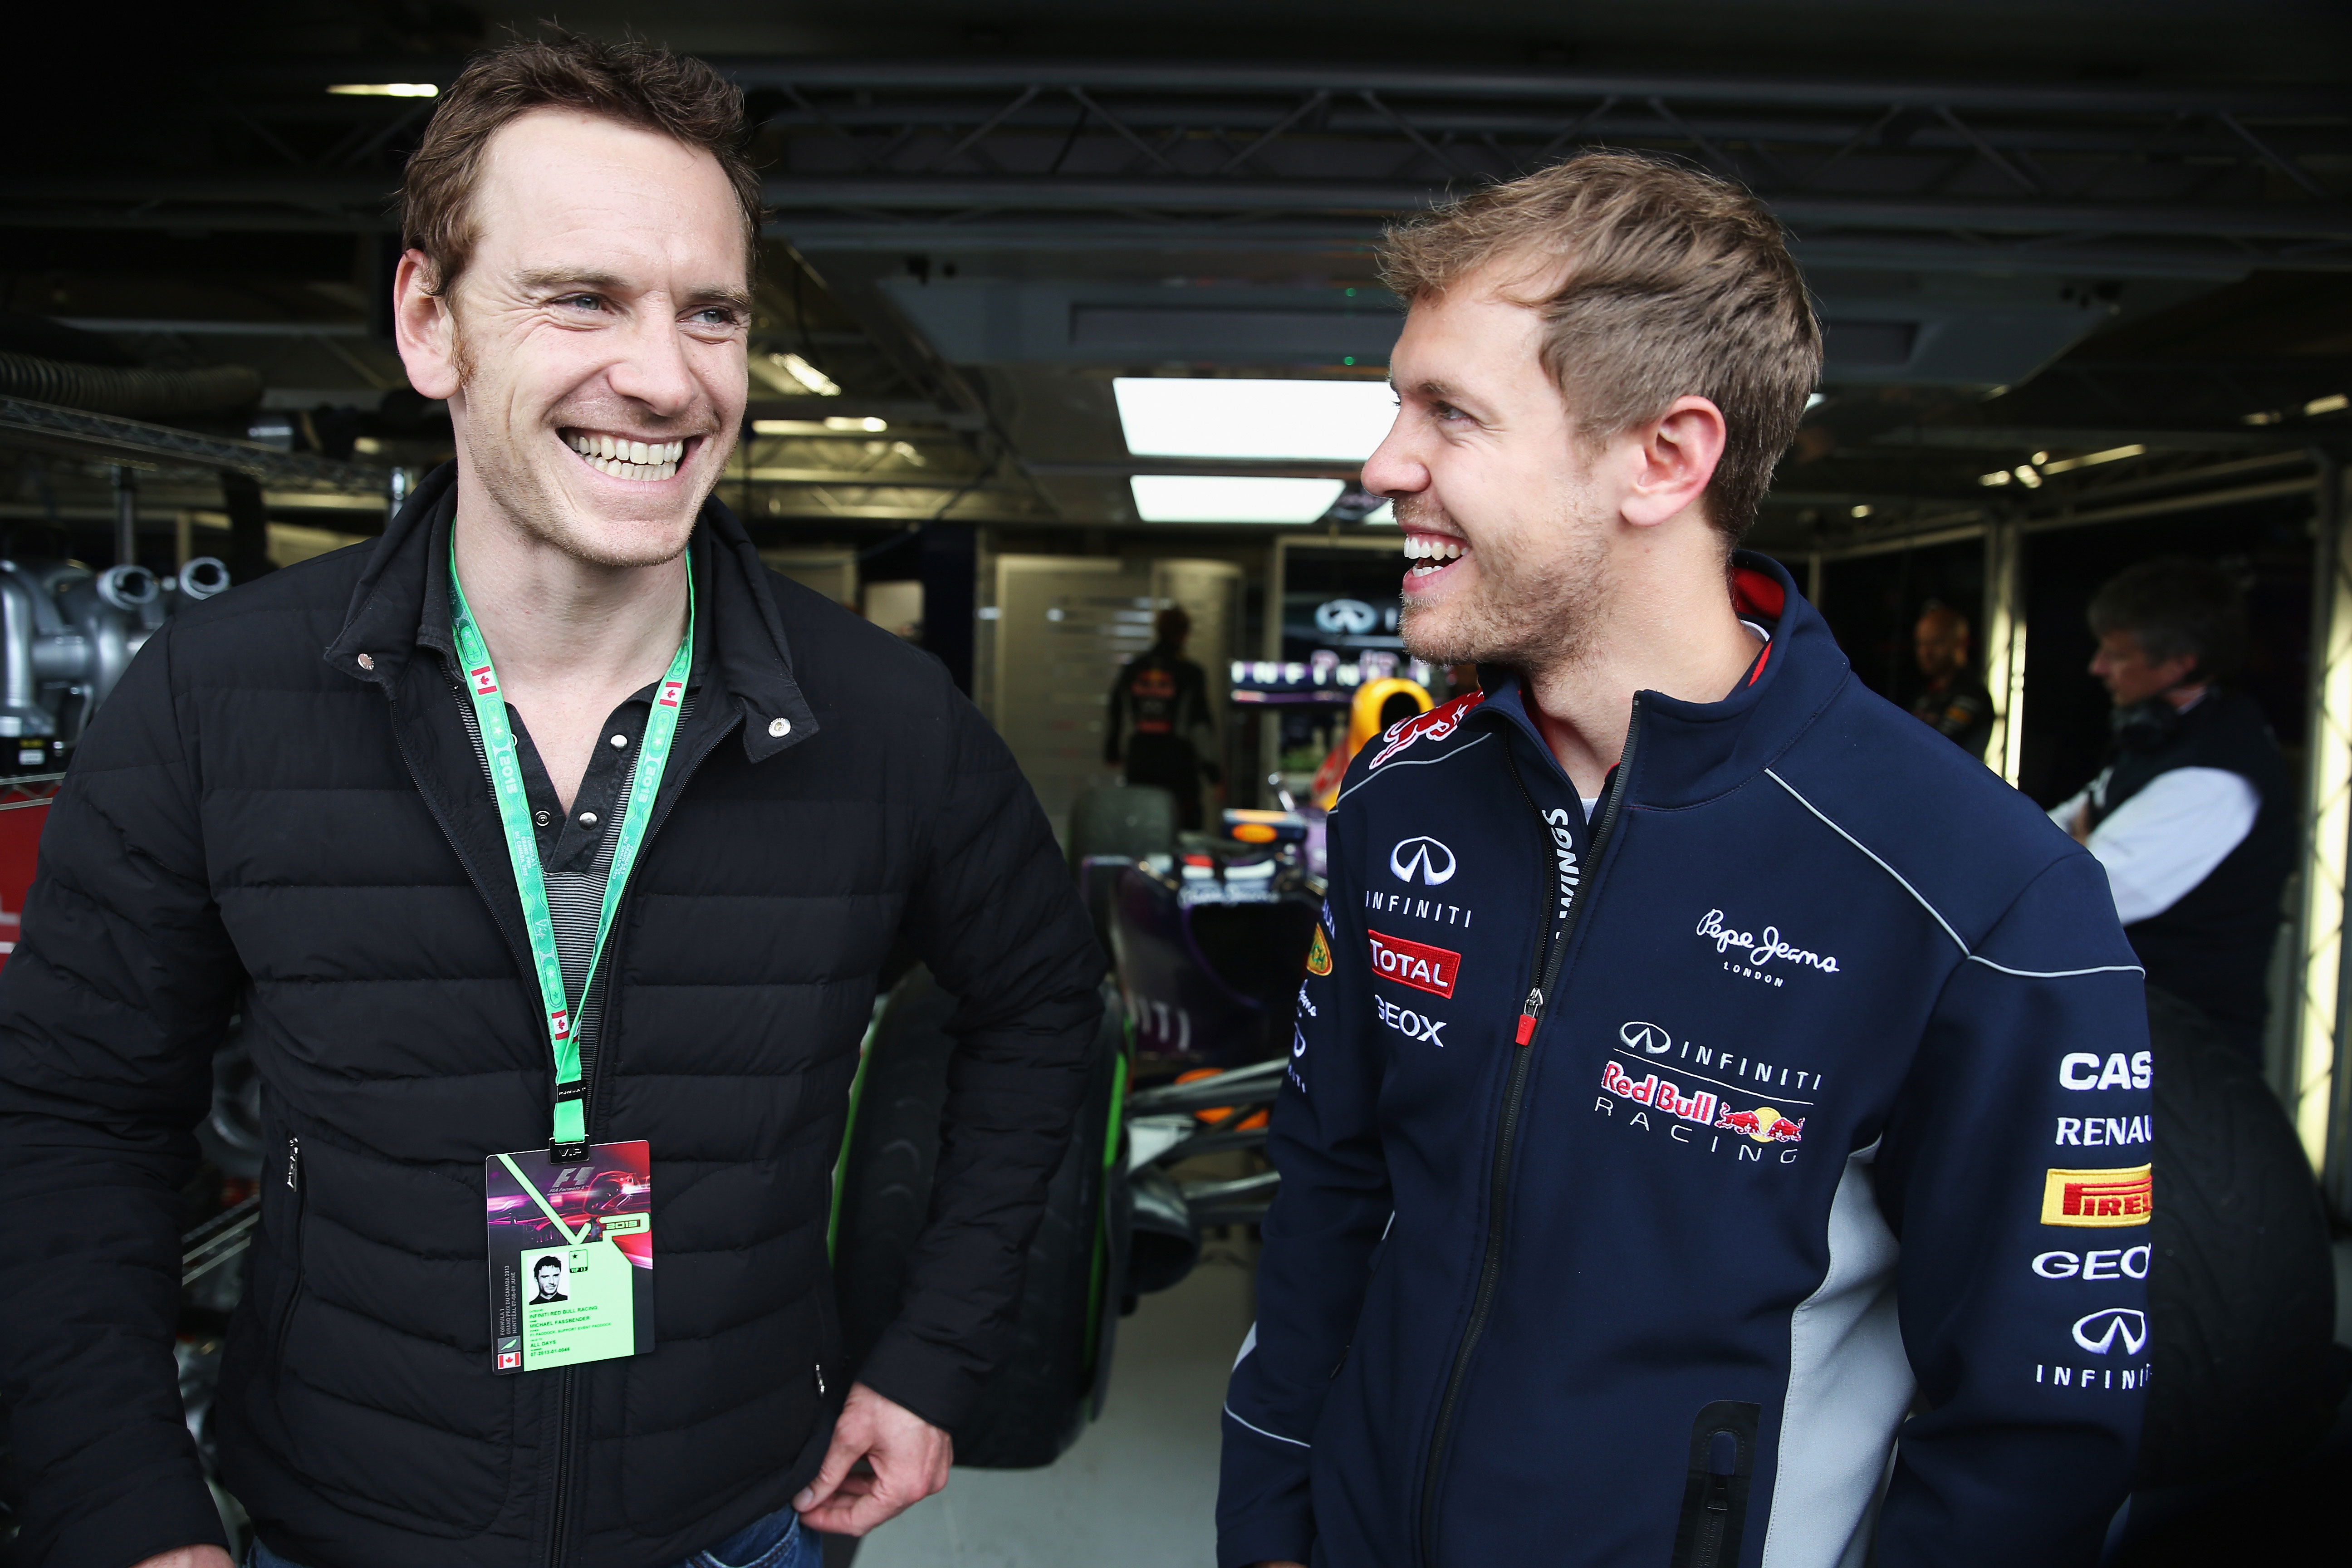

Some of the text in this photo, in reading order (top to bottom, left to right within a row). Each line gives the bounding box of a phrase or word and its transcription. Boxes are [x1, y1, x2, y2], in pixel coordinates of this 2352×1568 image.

[499, 755, 518, 794] 2013
[1366, 890, 1471, 928] INFINITI
[1696, 908, 1840, 973] Pepe Jeans
[1369, 939, 1449, 987] TOTAL
[1724, 960, 1784, 987] LONDON
[1374, 994, 1446, 1048] GEOX
[1681, 1041, 1821, 1090] INFINITI
[1594, 1096, 1798, 1164] RACING
[606, 1220, 638, 1230] 2013
[554, 1316, 590, 1325] FASSBENDER
